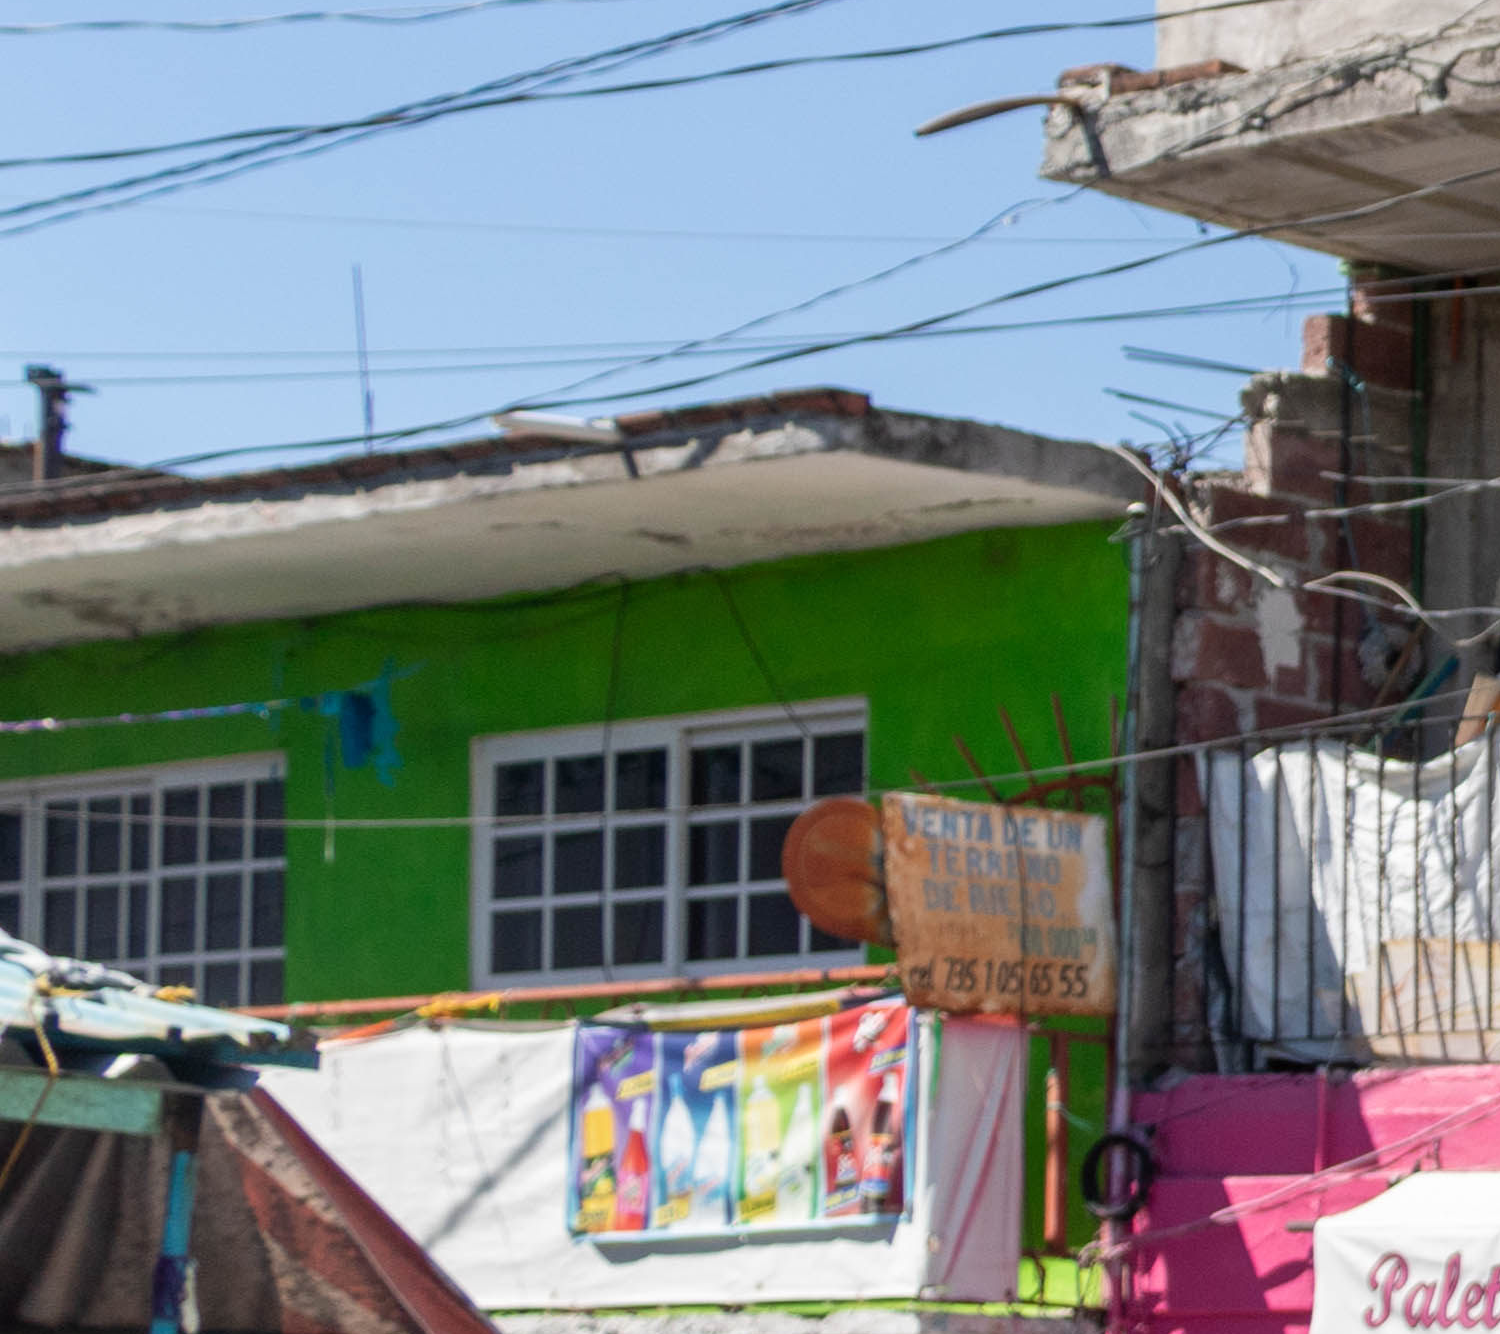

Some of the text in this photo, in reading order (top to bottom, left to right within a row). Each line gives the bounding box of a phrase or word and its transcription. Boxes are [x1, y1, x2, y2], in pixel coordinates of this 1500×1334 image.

[903, 803, 993, 843] VENTA
[1003, 813, 1038, 848] DE
[1060, 965, 1090, 998] 55
